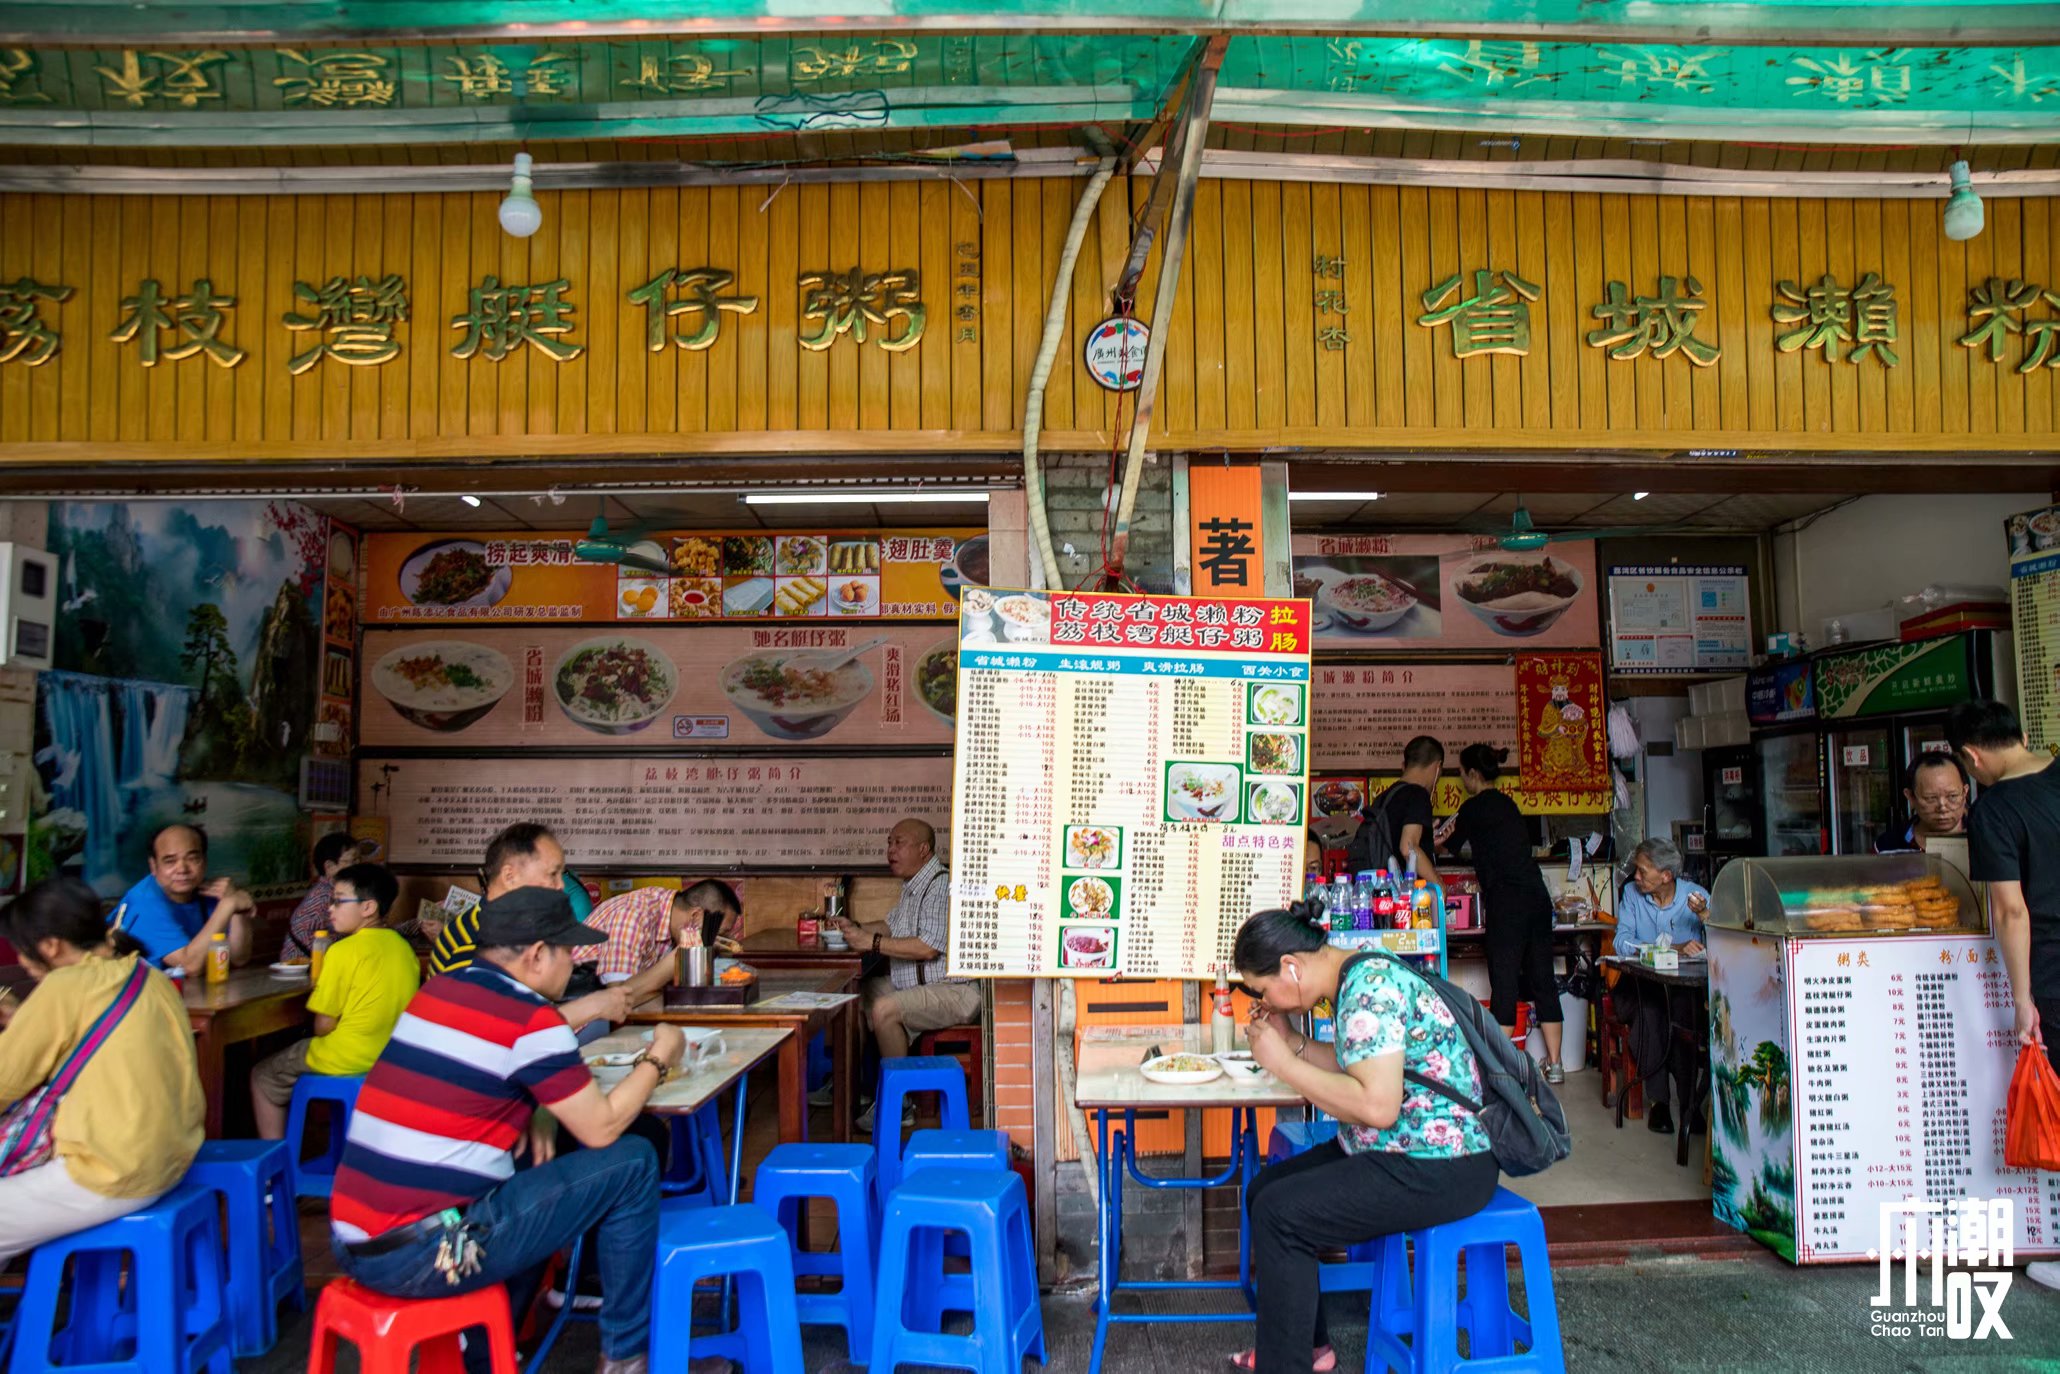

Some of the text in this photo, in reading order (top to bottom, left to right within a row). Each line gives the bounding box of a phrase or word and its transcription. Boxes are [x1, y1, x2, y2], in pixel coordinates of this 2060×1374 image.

[1054, 599, 1264, 626] 传统省城濑粉
[1053, 621, 1264, 649] 荔枝湾艇仔粥
[1222, 834, 1295, 849] 甜点特色类
